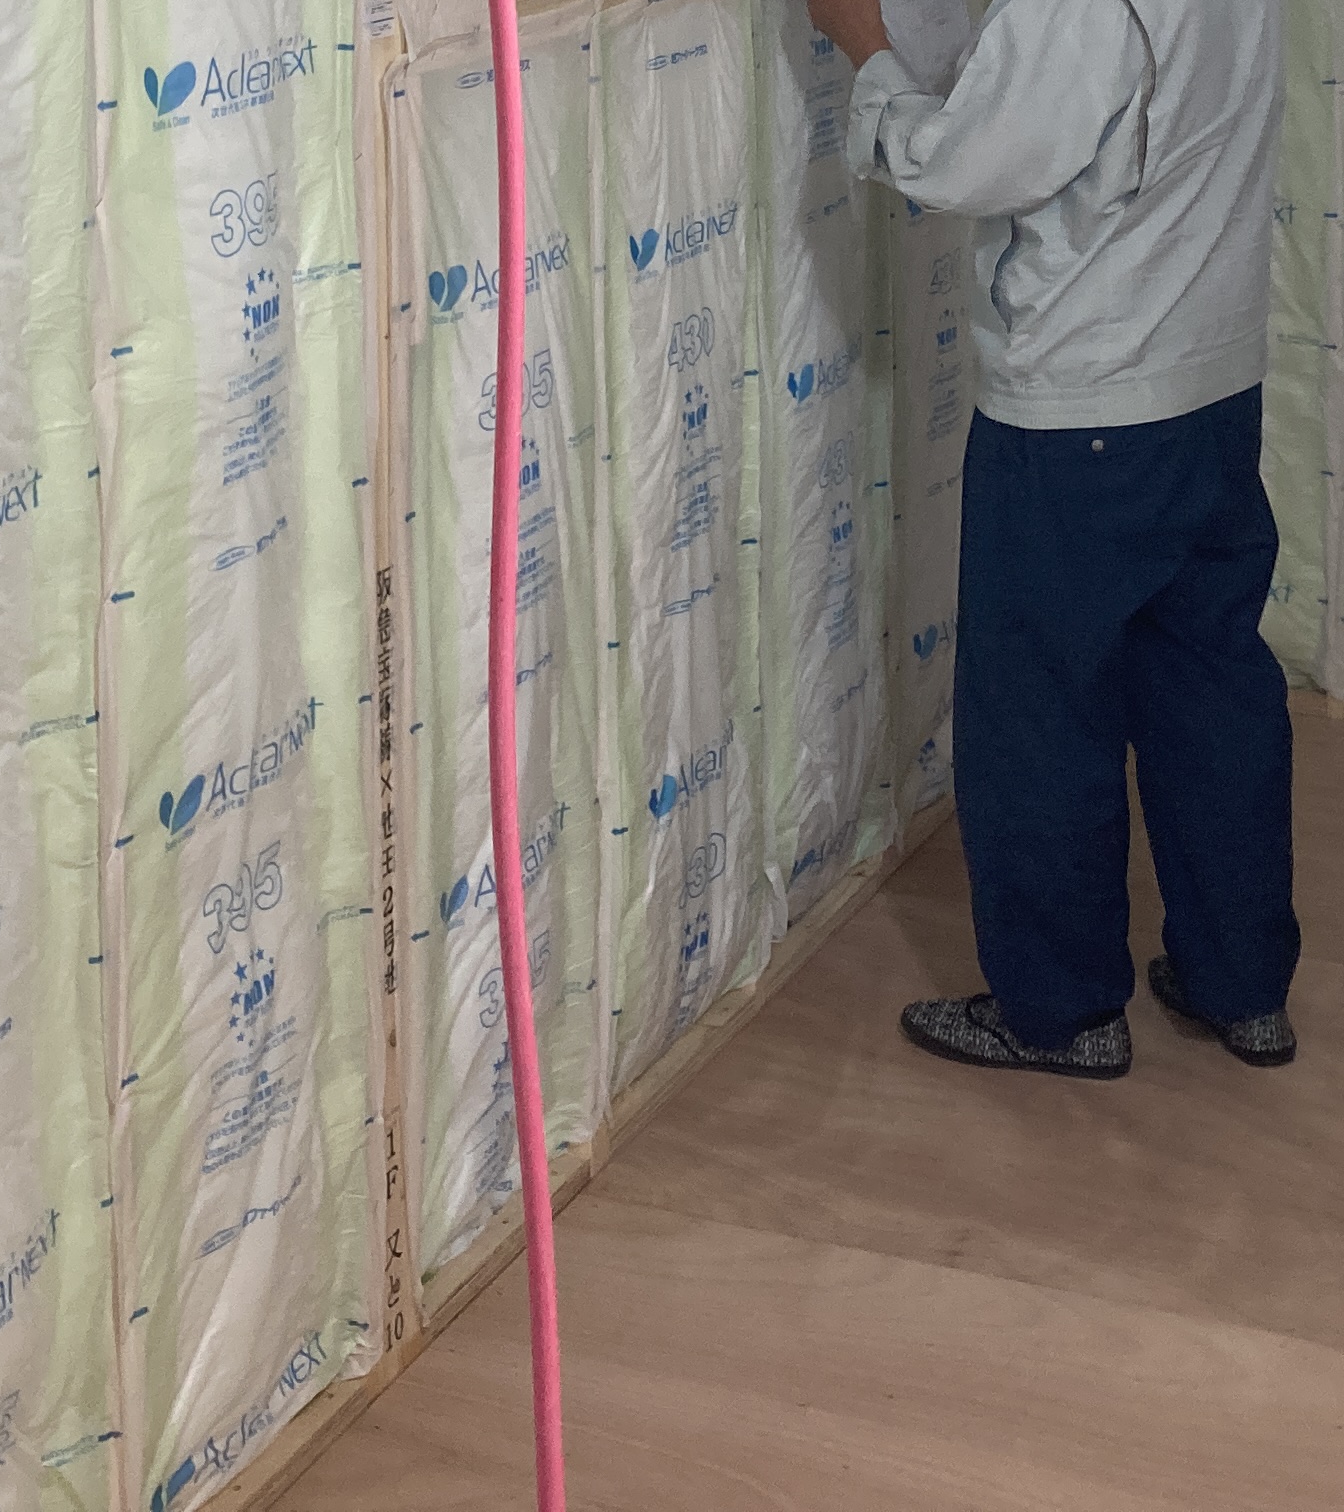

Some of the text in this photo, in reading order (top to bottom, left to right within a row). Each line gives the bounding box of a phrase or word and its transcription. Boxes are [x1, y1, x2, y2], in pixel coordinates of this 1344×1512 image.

[251, 294, 280, 330] NON
[667, 307, 715, 373] 430
[478, 348, 553, 432] 35
[520, 459, 541, 487] ON
